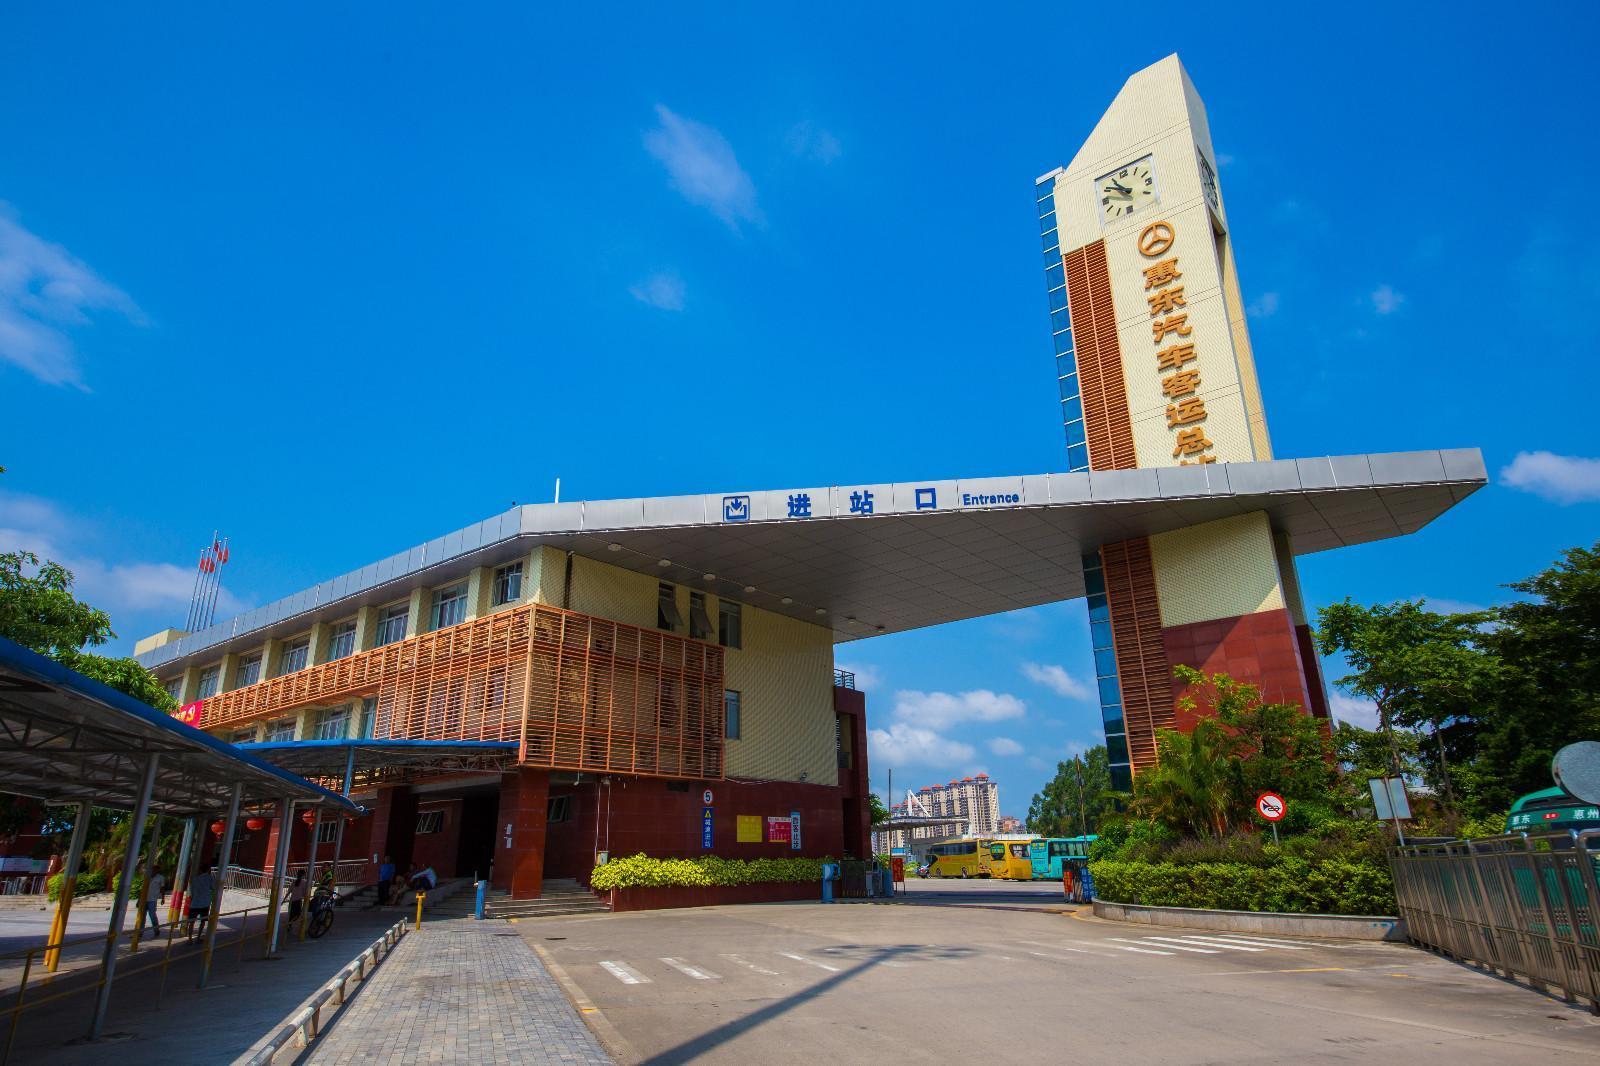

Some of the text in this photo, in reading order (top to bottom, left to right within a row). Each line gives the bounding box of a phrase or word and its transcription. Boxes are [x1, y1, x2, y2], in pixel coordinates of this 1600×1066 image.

[1142, 256, 1217, 466] 惠东汽车客运总
[787, 487, 1020, 518] 进站口 Entrance
